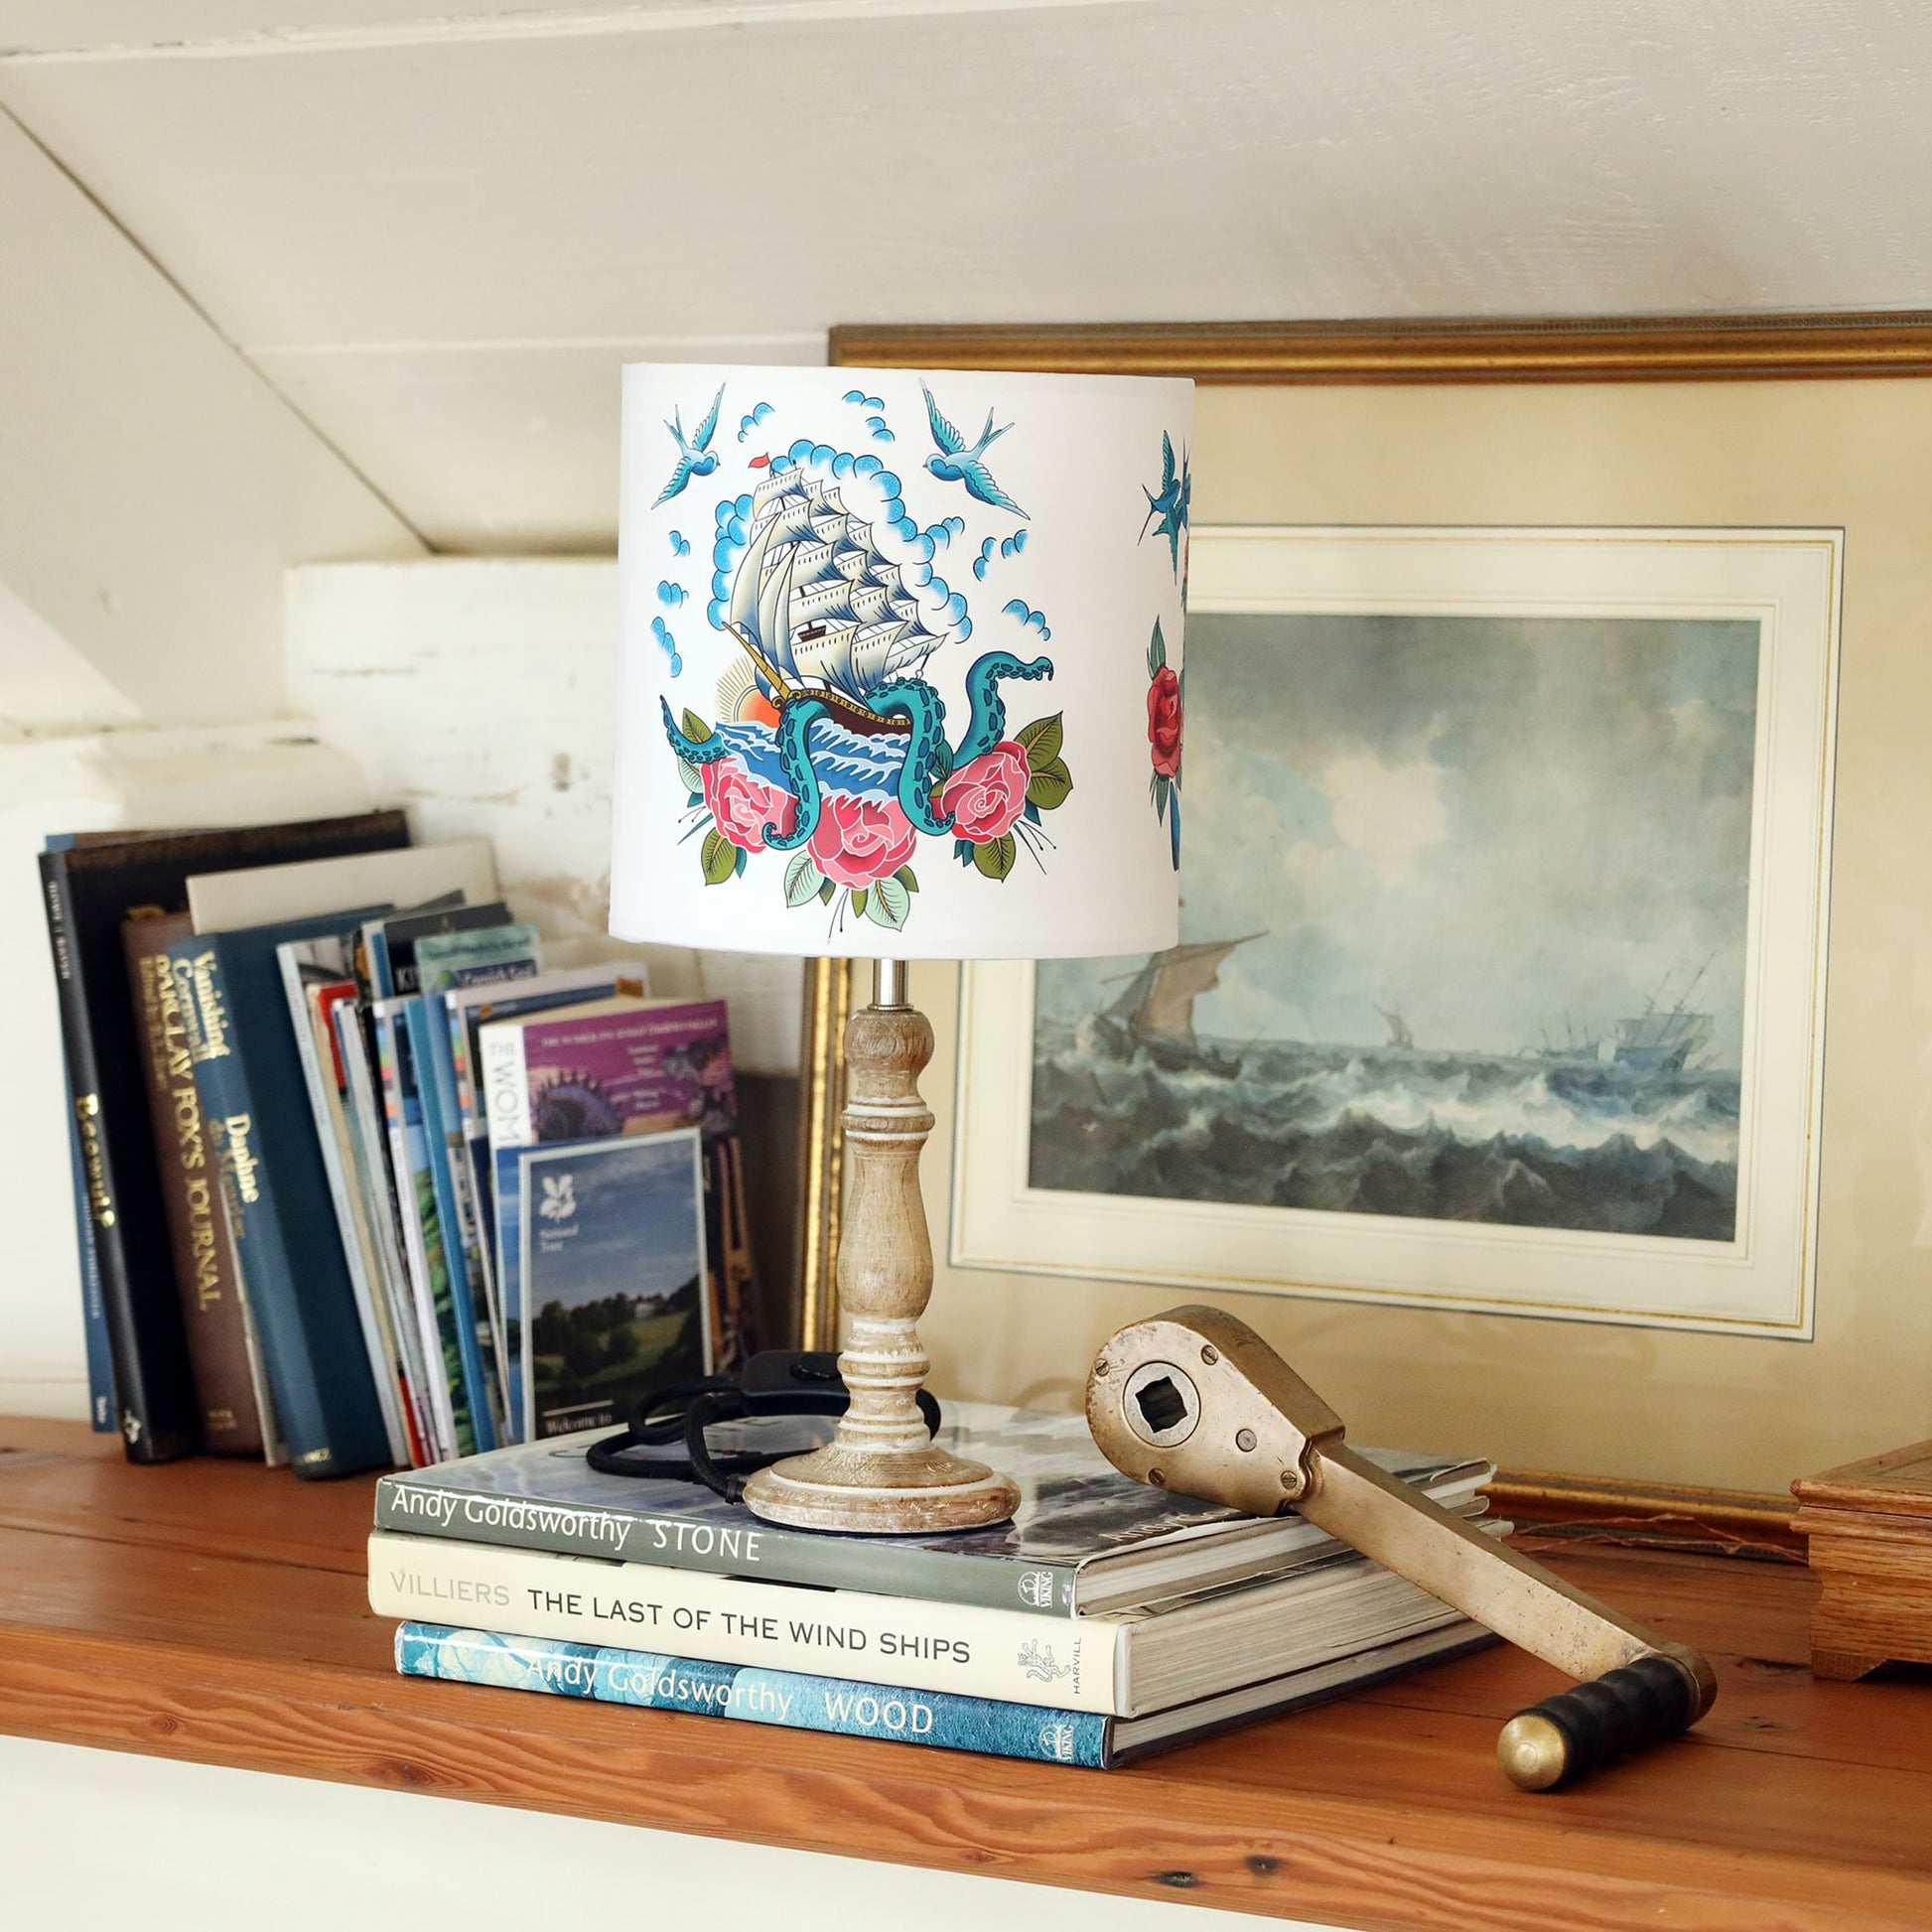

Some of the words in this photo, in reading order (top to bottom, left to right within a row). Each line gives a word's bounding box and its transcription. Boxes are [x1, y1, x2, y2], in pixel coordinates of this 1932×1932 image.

[193, 949, 230, 1059] Vanishing
[75, 1093, 115, 1228] Beowulf
[225, 1112, 260, 1203] Daphne
[184, 1175, 221, 1311] JOURNAL
[391, 1486, 458, 1527] Andy
[465, 1495, 631, 1551] Goldsworthy
[652, 1521, 760, 1562] STONE
[390, 1572, 510, 1606] VILLIERS
[527, 1588, 583, 1616] THE
[593, 1596, 663, 1625] LAST
[672, 1607, 711, 1631] OF
[721, 1612, 778, 1640] THE
[789, 1621, 868, 1651] WIND
[880, 1632, 971, 1664] SHIPS
[1040, 1571, 1053, 1608] VIKING
[526, 1655, 598, 1694] Andy
[607, 1662, 793, 1722] Goldsworthy
[823, 1691, 934, 1733] WOOD
[1072, 1637, 1082, 1694] HARVILL
[1060, 1725, 1075, 1761] VIKING
